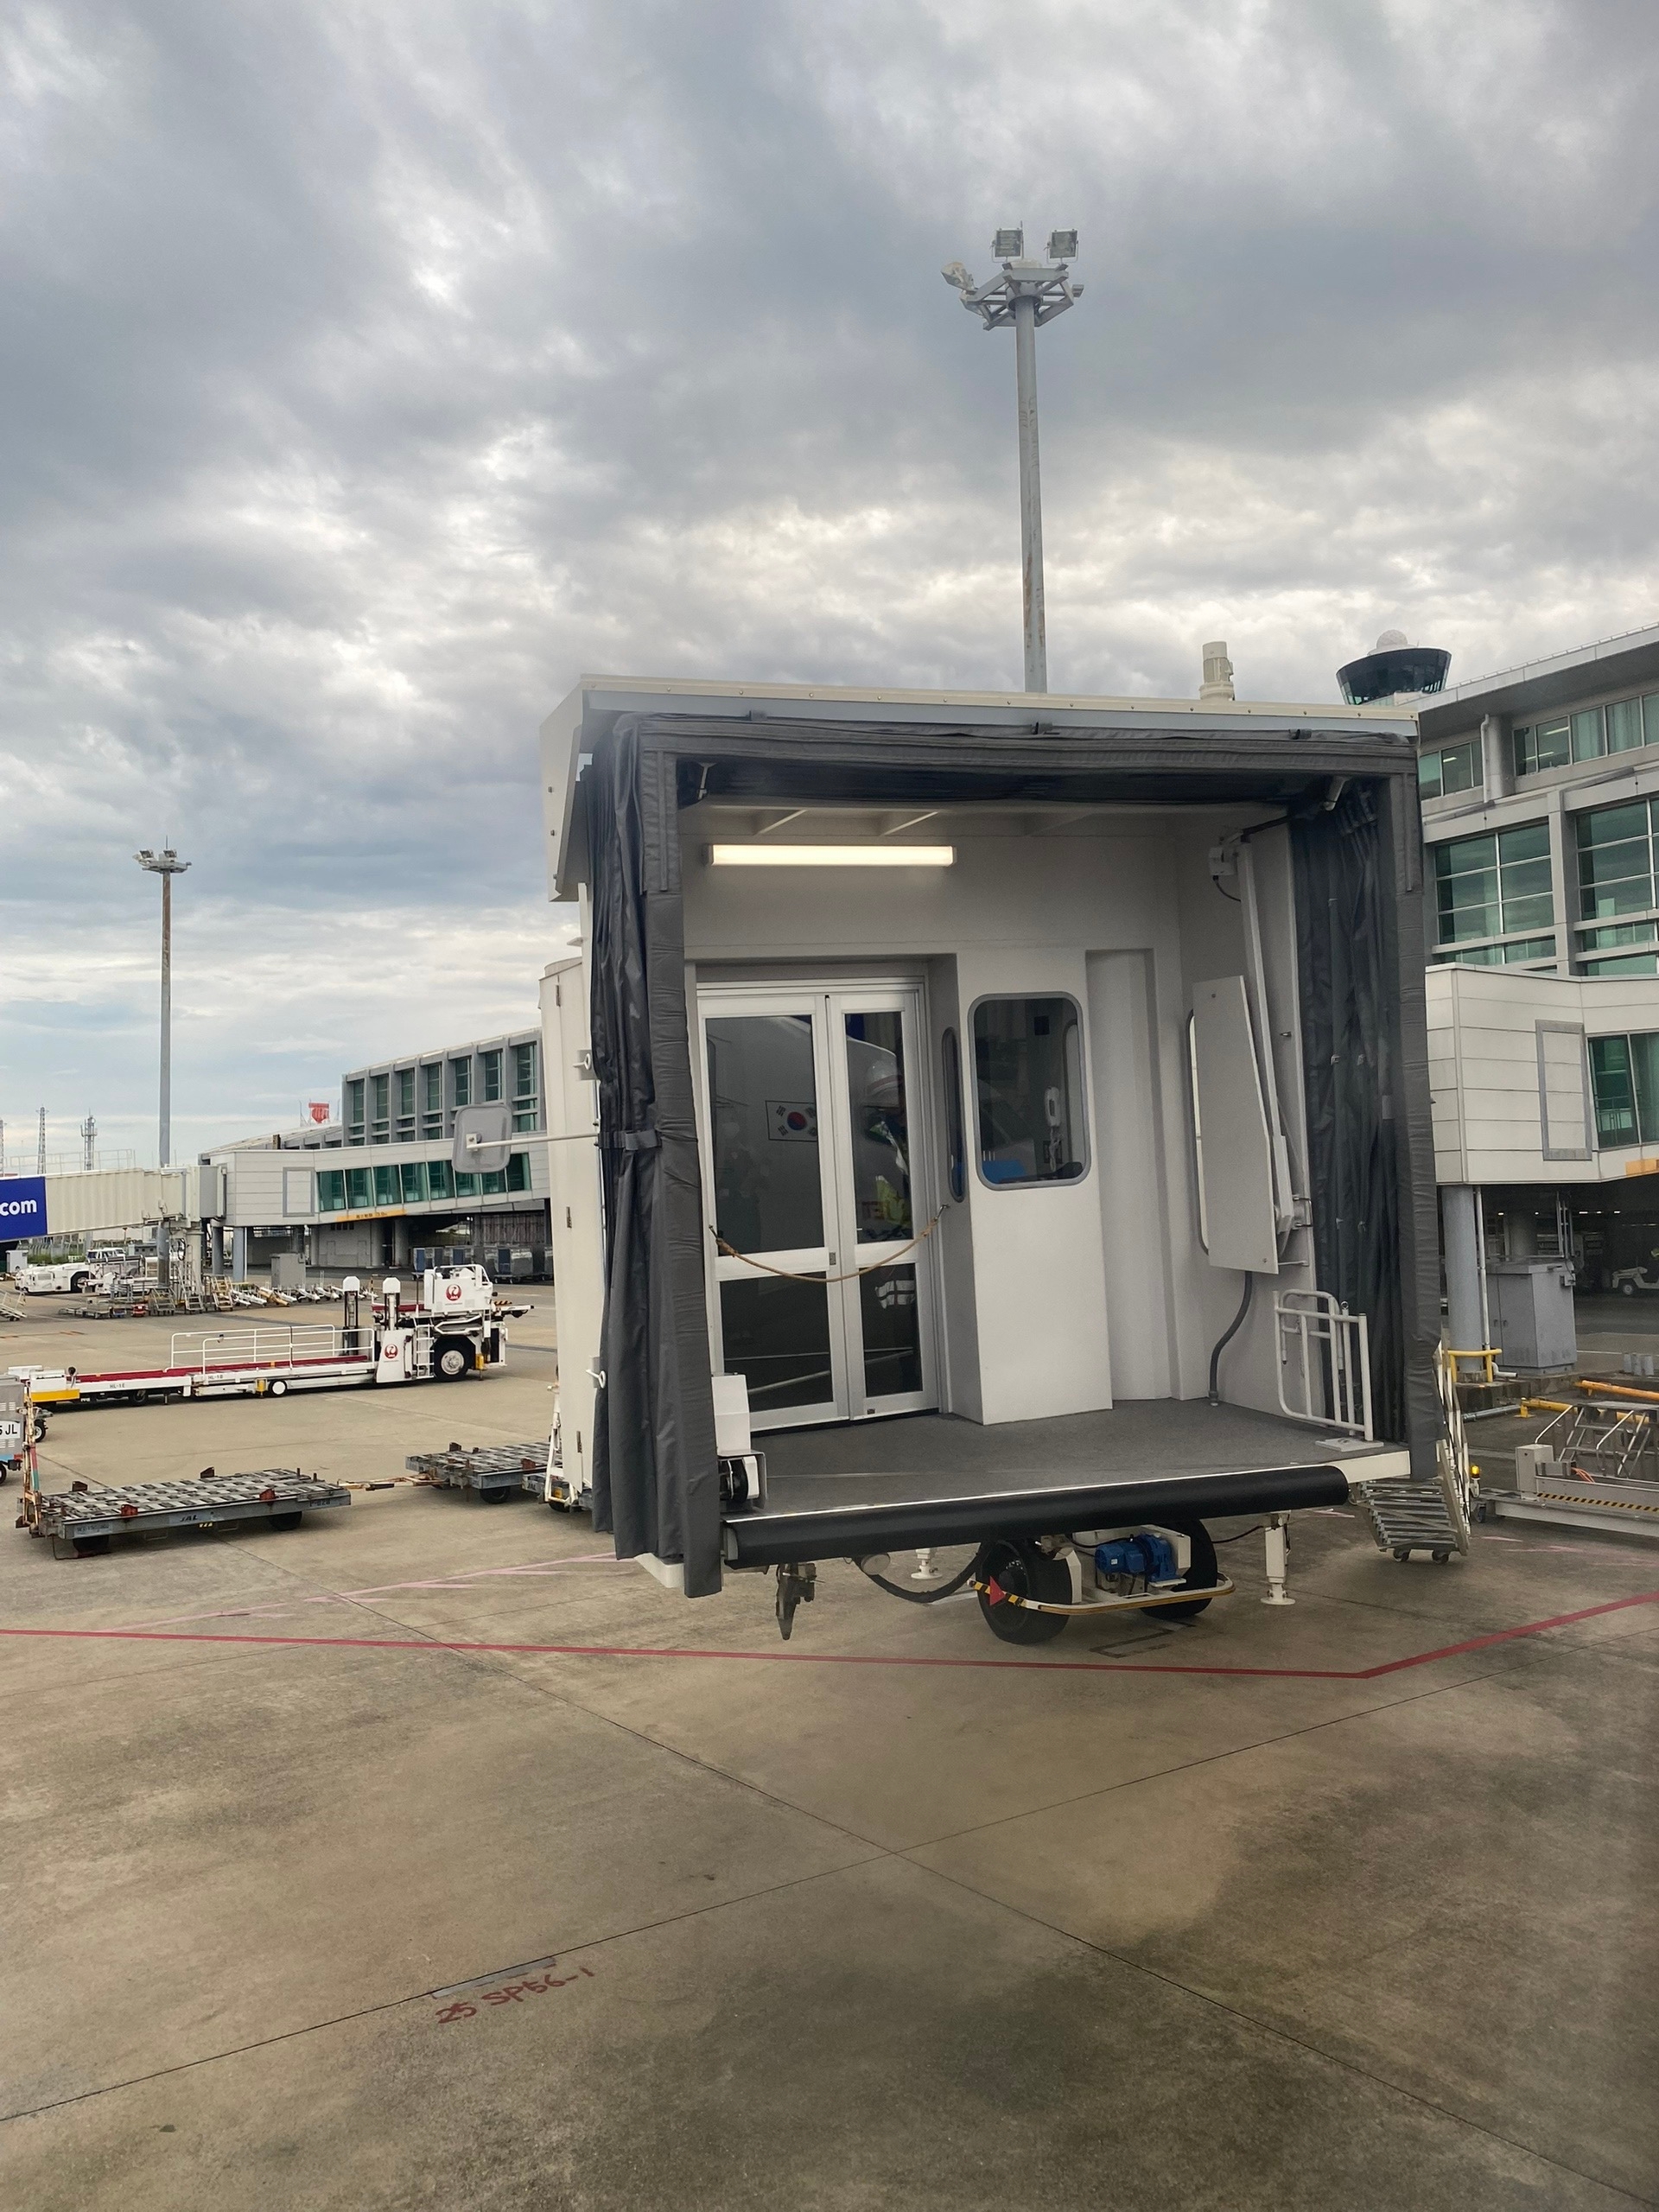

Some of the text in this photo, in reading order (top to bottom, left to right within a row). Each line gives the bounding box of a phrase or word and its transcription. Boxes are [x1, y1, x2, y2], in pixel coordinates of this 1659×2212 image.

[5, 1423, 17, 1435] JL
[180, 1514, 199, 1522] JAL
[435, 2001, 478, 2024] 25
